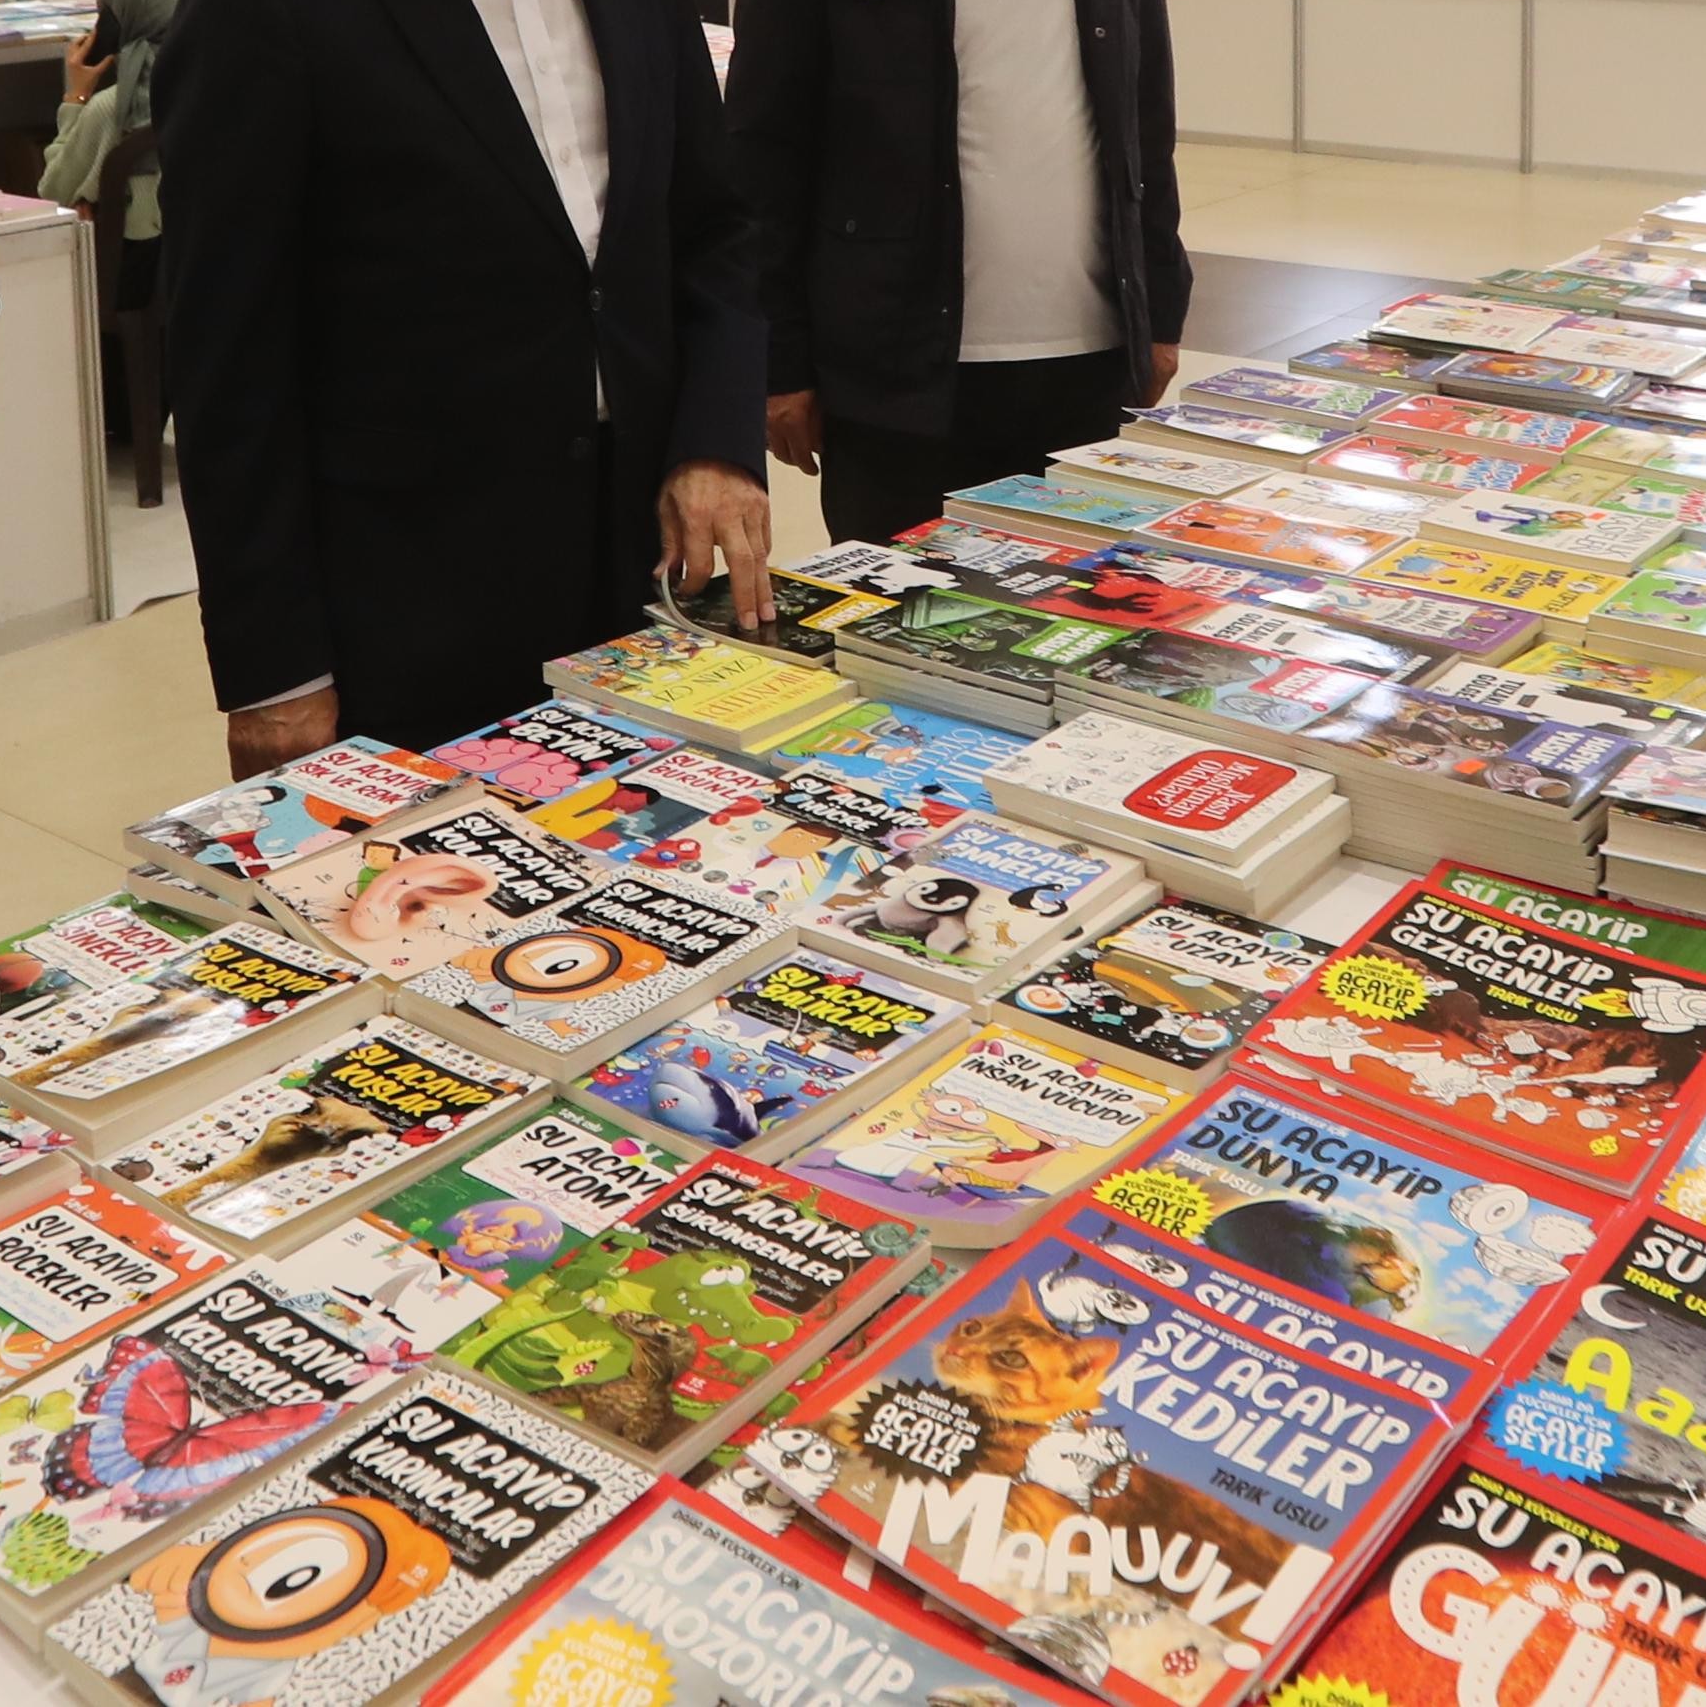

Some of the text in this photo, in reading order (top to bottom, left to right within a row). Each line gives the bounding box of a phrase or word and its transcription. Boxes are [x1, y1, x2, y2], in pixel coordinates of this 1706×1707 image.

[509, 722, 613, 763] BEYİN
[648, 764, 744, 800] BURUNL
[582, 897, 720, 953] KARINCALAR
[1504, 895, 1648, 944] ACAYİP
[1170, 940, 1257, 969] UZAY
[1392, 924, 1592, 1010] GEZEGENLER
[1468, 924, 1615, 986] ACAYİP
[756, 983, 892, 1038] BALIKLAR
[1486, 983, 1579, 1023] TARIK USLU
[330, 1062, 443, 1117] KUŞLAR
[960, 1055, 1144, 1125] İNSAN VÜCUDU
[519, 1156, 631, 1210] ATOM
[1186, 1125, 1339, 1203] DÜNYA
[1280, 1125, 1443, 1200] ACAYİP
[660, 1202, 845, 1287] SÜRÜNGENLER
[1624, 1265, 1679, 1304] TARIK
[873, 1402, 978, 1456] ACAYİP
[1097, 1350, 1375, 1512] KEDİLER
[1213, 1355, 1412, 1454] ACAYİP
[1505, 1404, 1614, 1451] ACAYİP
[349, 1435, 535, 1549] KARINCALAR
[1210, 1466, 1330, 1532] TARIK USLU
[707, 1571, 915, 1693] ACAYİP
[1619, 1622, 1685, 1666] TARIK
